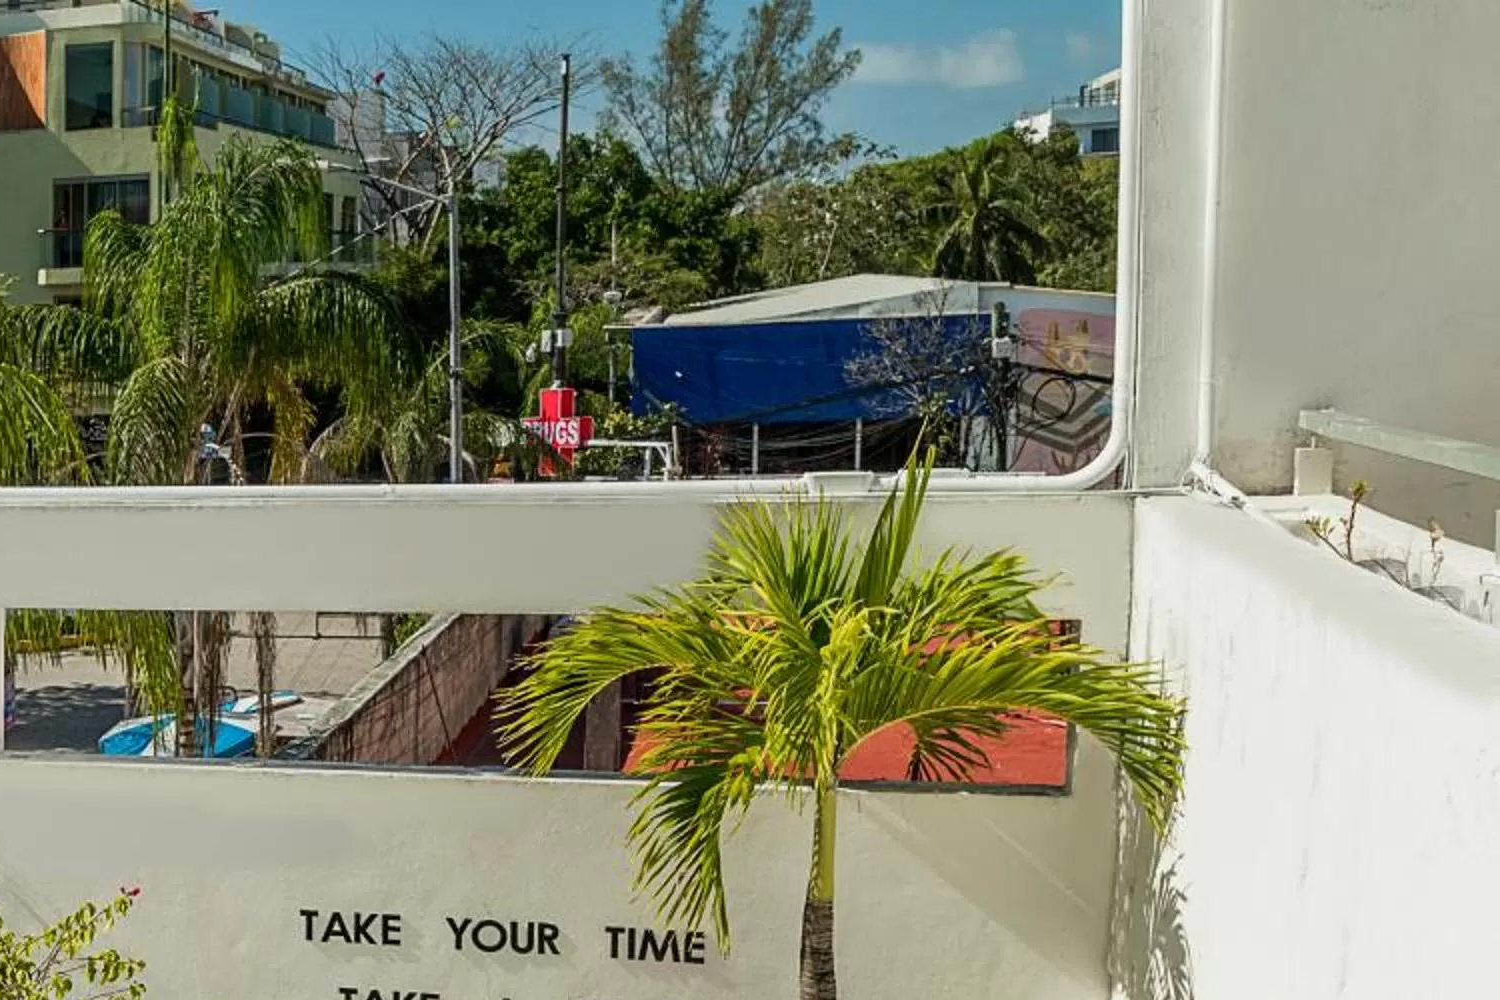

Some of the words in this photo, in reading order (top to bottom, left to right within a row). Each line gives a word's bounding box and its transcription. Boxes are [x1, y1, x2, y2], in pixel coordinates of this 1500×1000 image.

[299, 909, 401, 946] TAKE
[445, 917, 560, 955] YOUR
[604, 926, 706, 965] TIME
